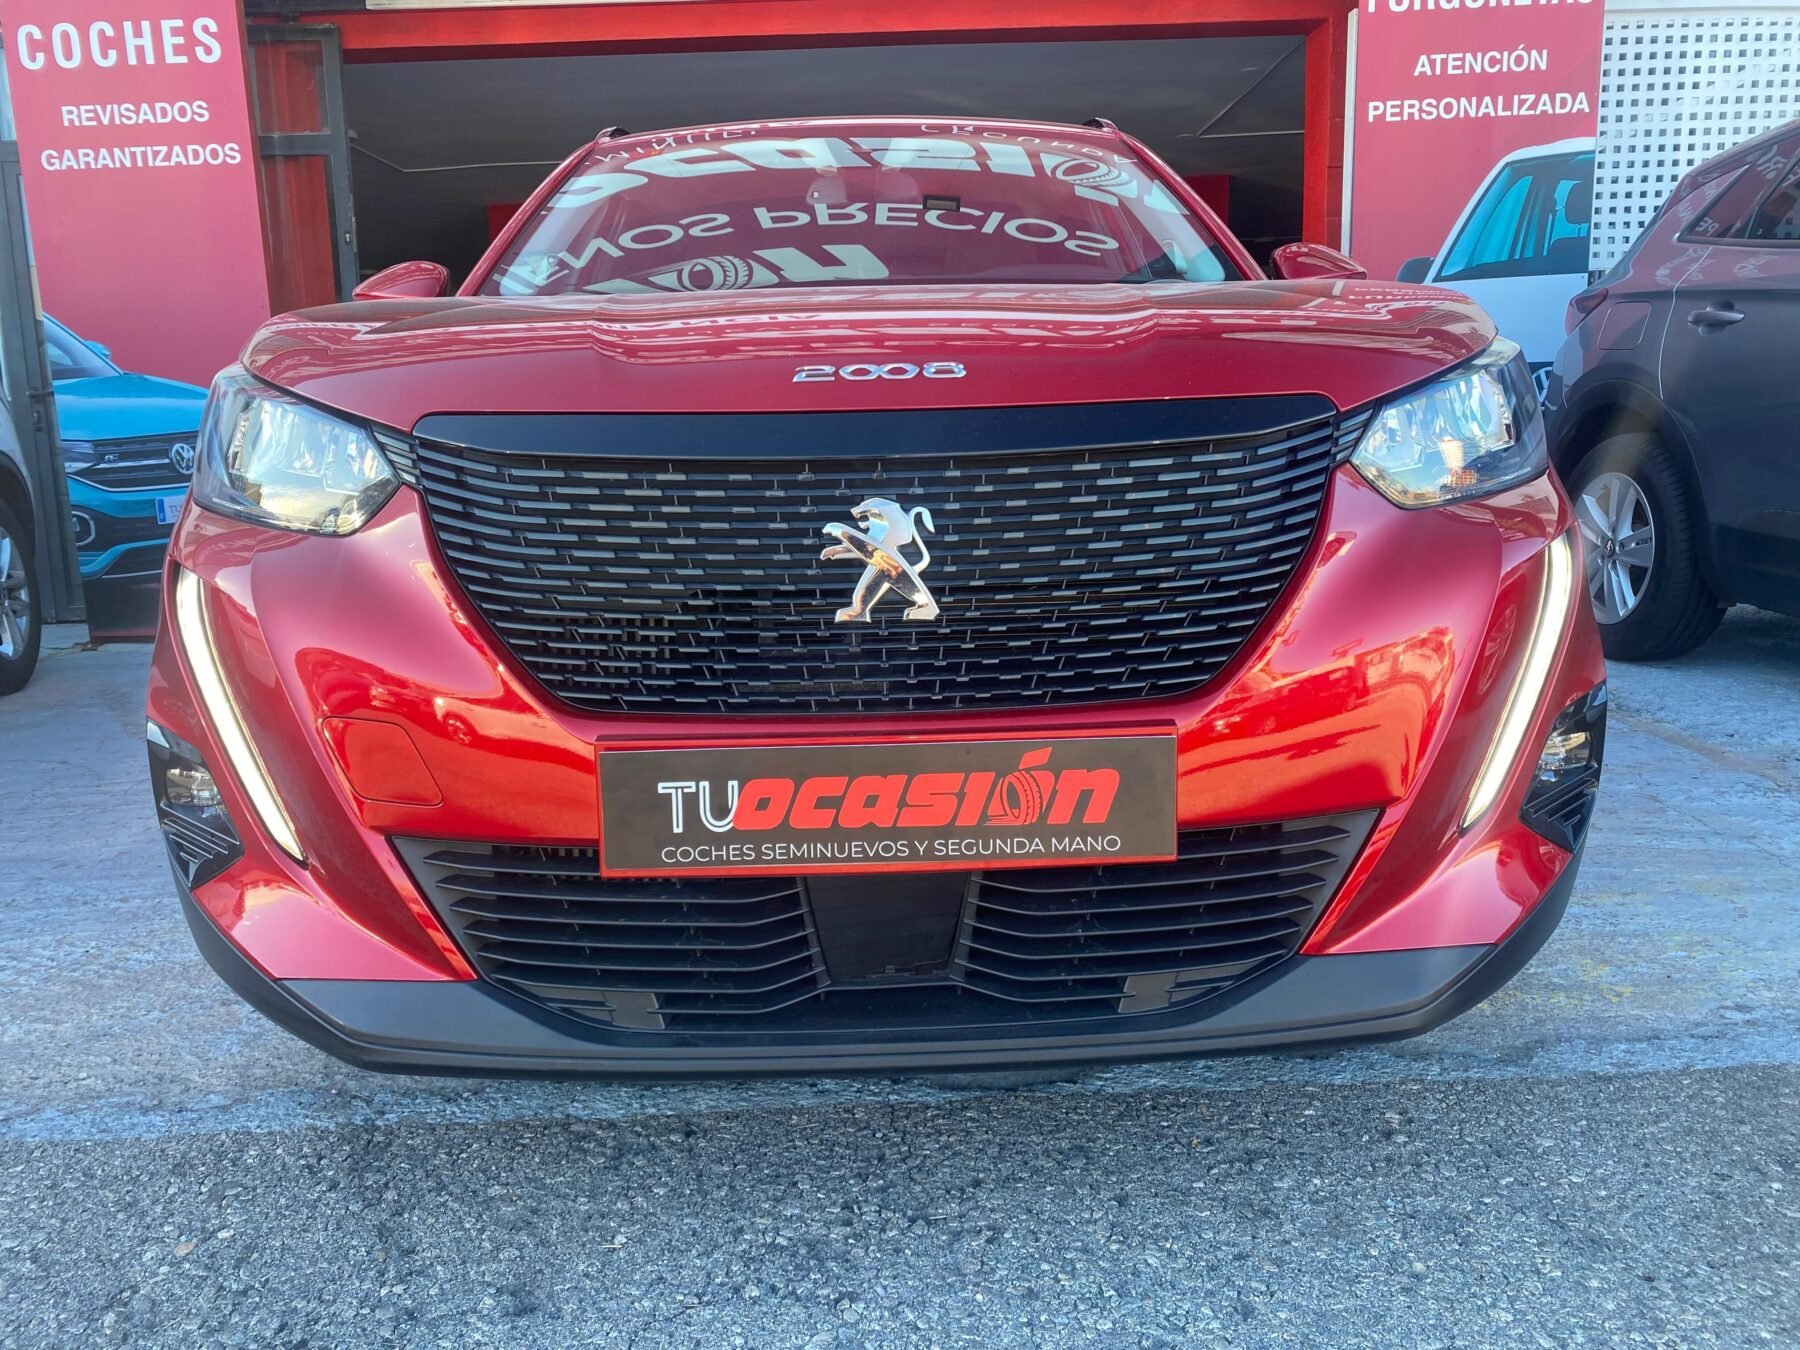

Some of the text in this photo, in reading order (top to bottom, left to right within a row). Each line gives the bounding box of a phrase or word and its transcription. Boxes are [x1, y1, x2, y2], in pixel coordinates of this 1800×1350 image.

[17, 17, 222, 70] COCHES
[1413, 44, 1548, 77] ATENCIÓN
[61, 101, 209, 126] REVISADOS
[1368, 92, 1590, 123] PERSONALIZADA
[40, 143, 241, 171] GARANTIZADOS
[792, 362, 967, 382] 2008
[661, 835, 1121, 863] COCHES SEMINUEVOS Y SEGUNDA MANO
